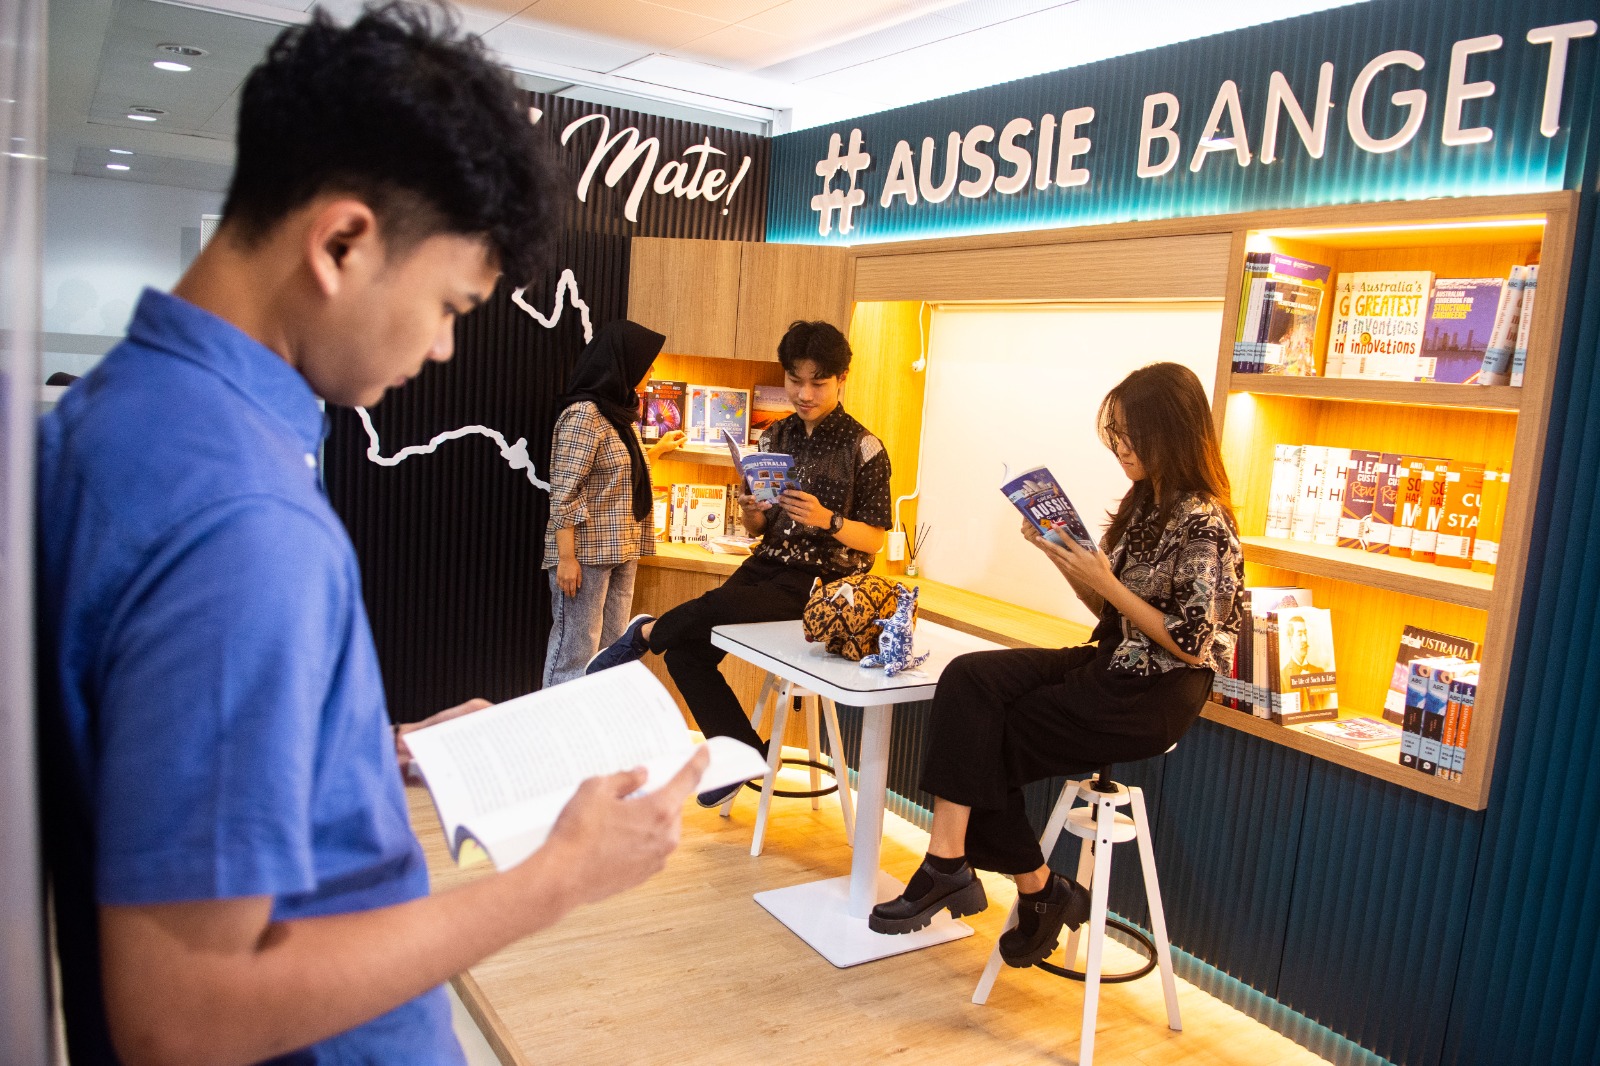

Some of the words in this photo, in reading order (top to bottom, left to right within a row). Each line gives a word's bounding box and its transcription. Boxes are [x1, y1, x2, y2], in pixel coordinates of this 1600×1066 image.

[1137, 20, 1597, 178] BANGET
[560, 113, 752, 223] Mate!
[1360, 281, 1422, 293] Australia's
[1355, 294, 1422, 317] GREATEST
[1353, 318, 1419, 336] inventions
[1350, 338, 1416, 355] innovations
[691, 487, 723, 500] POWERING
[690, 498, 699, 510] UP
[1030, 496, 1072, 520] AUSSIE
[1310, 676, 1321, 684] Such
[1411, 677, 1423, 685] ABC
[1449, 694, 1461, 702] ABC
[1462, 697, 1474, 705] ABC
